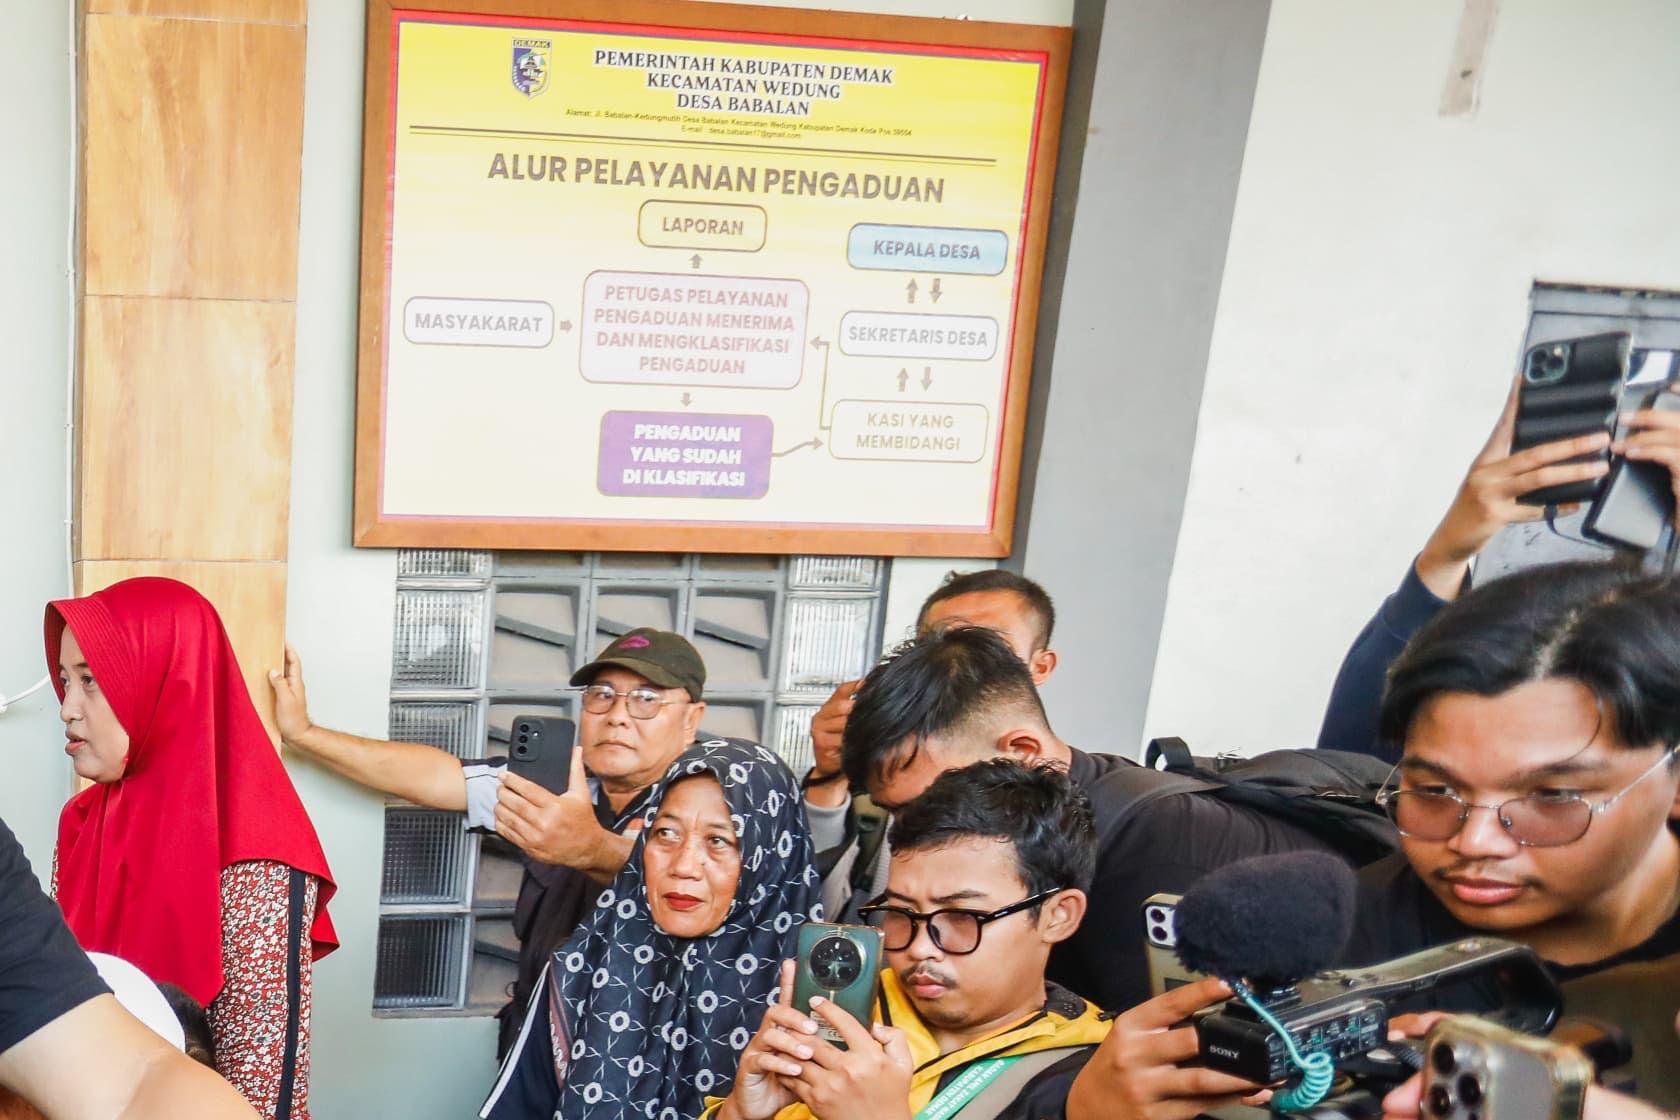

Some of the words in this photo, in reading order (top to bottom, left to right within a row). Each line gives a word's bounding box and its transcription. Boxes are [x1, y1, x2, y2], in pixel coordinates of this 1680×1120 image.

[595, 49, 716, 72] PEMERINTAH
[720, 57, 825, 80] KABUPATEN
[829, 66, 894, 84] DEMAK
[647, 72, 757, 94] KECAMATAN
[763, 80, 841, 99] WEDUNG
[677, 93, 722, 110] DESA
[727, 97, 810, 116] BABALAN
[487, 152, 568, 183] ALUR
[574, 157, 756, 193] PELAYANAN
[763, 167, 945, 203] PENGADUAN
[661, 216, 744, 238] LAPORAN
[873, 239, 936, 258] KEPALA
[939, 244, 981, 260] DESA
[604, 285, 683, 303] PETUGAS
[687, 288, 789, 308] PELAYANAN
[414, 312, 543, 333] MASYAKARAT
[593, 308, 702, 327] PENGADUAN
[705, 312, 795, 332] MENERIMA
[596, 331, 634, 347] DAN
[638, 333, 789, 354] MENGKLASIFIKASI
[848, 325, 944, 345] SEKRETARIS
[947, 330, 988, 347] DESA
[639, 356, 745, 374] PENGADUAN
[867, 412, 905, 428] KASI
[908, 413, 954, 430] YANG
[634, 423, 742, 442] PENGADUAN
[856, 434, 961, 452] MEMBIDANGI
[630, 446, 681, 464] YANG
[683, 448, 742, 465] SUDAH
[623, 468, 640, 485] DI
[643, 469, 746, 487] KLASIFIKASI
[1209, 1044, 1240, 1060] SONY
